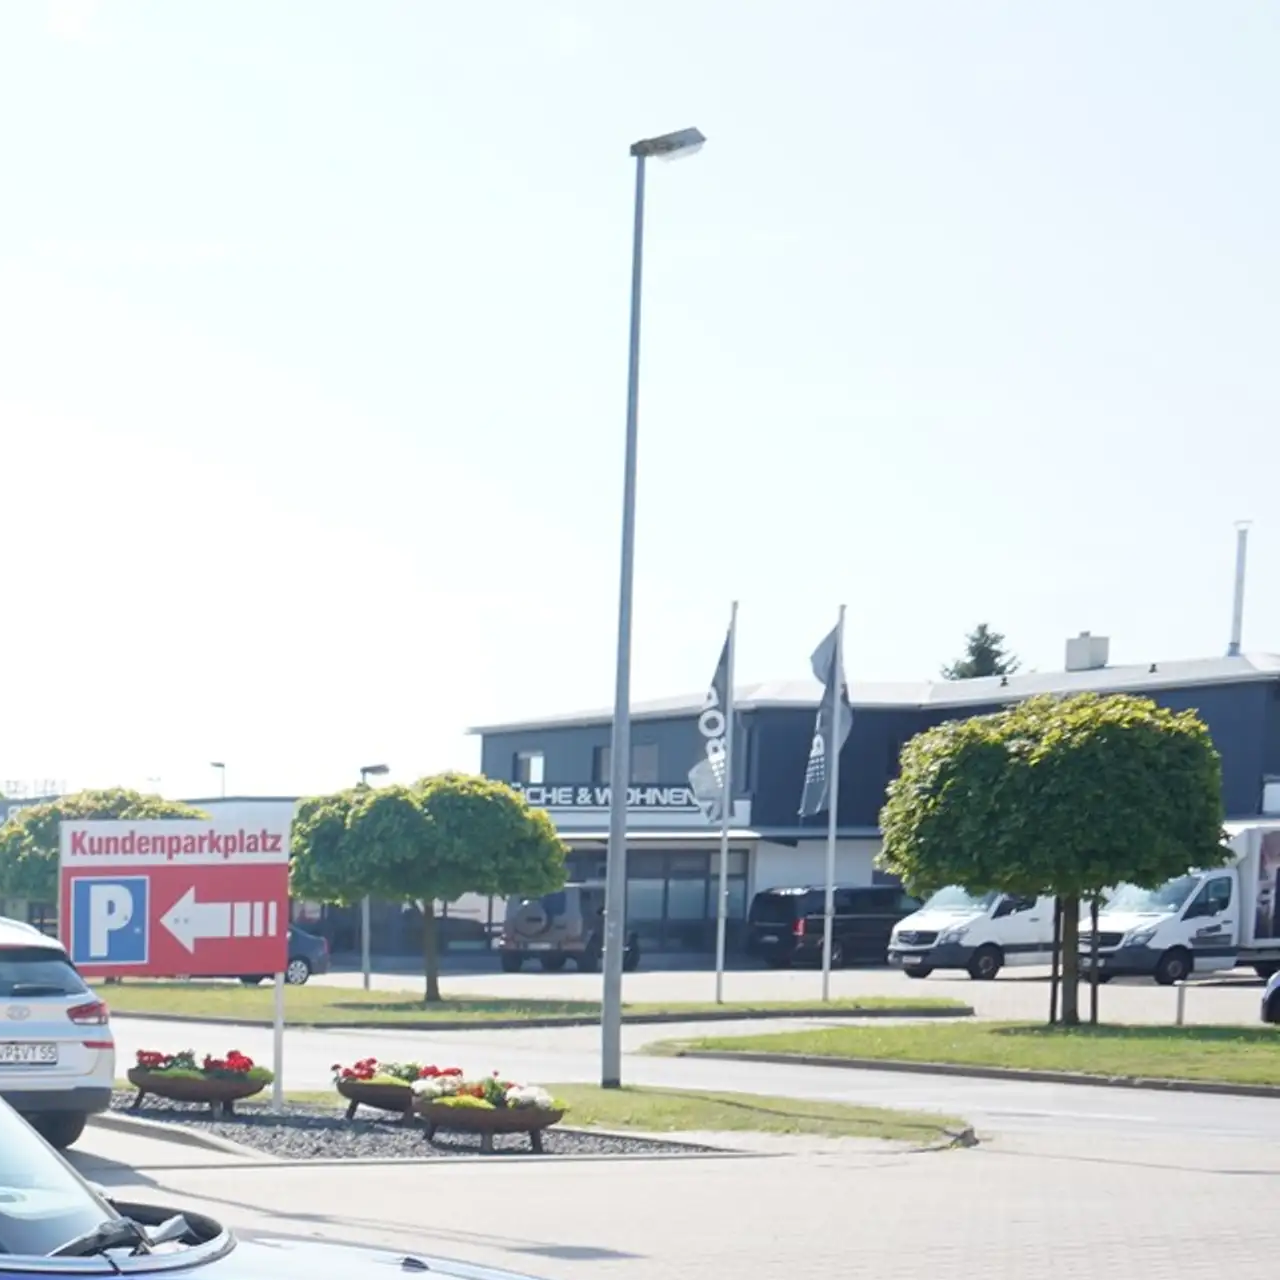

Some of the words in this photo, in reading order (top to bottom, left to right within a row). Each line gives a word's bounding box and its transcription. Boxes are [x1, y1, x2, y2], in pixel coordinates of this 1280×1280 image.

[576, 787, 592, 805] &
[70, 828, 283, 861] Kundenparkplatz
[89, 883, 134, 957] P
